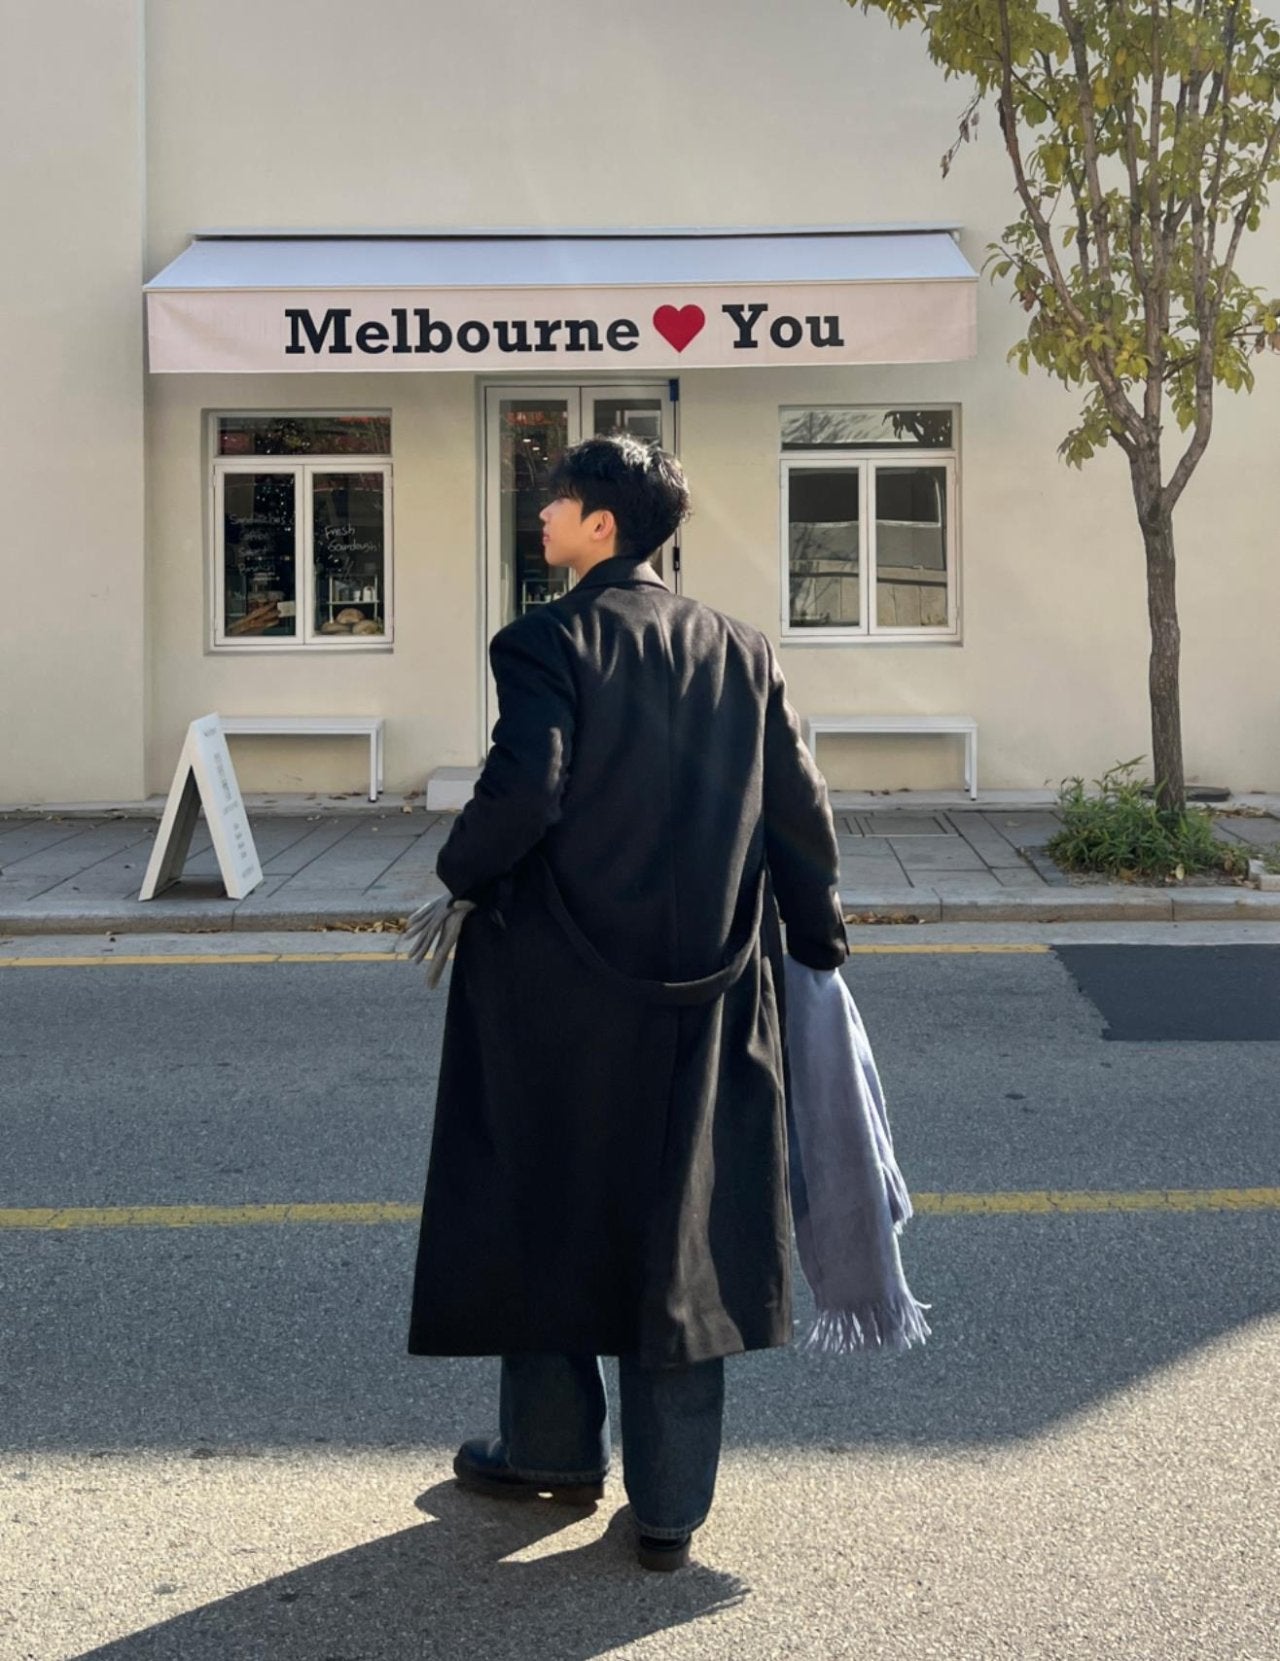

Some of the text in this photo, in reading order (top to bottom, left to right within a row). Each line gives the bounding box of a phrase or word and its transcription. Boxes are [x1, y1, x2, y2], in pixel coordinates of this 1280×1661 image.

[285, 303, 845, 354] Melbourne You
[324, 521, 356, 540] Fresh
